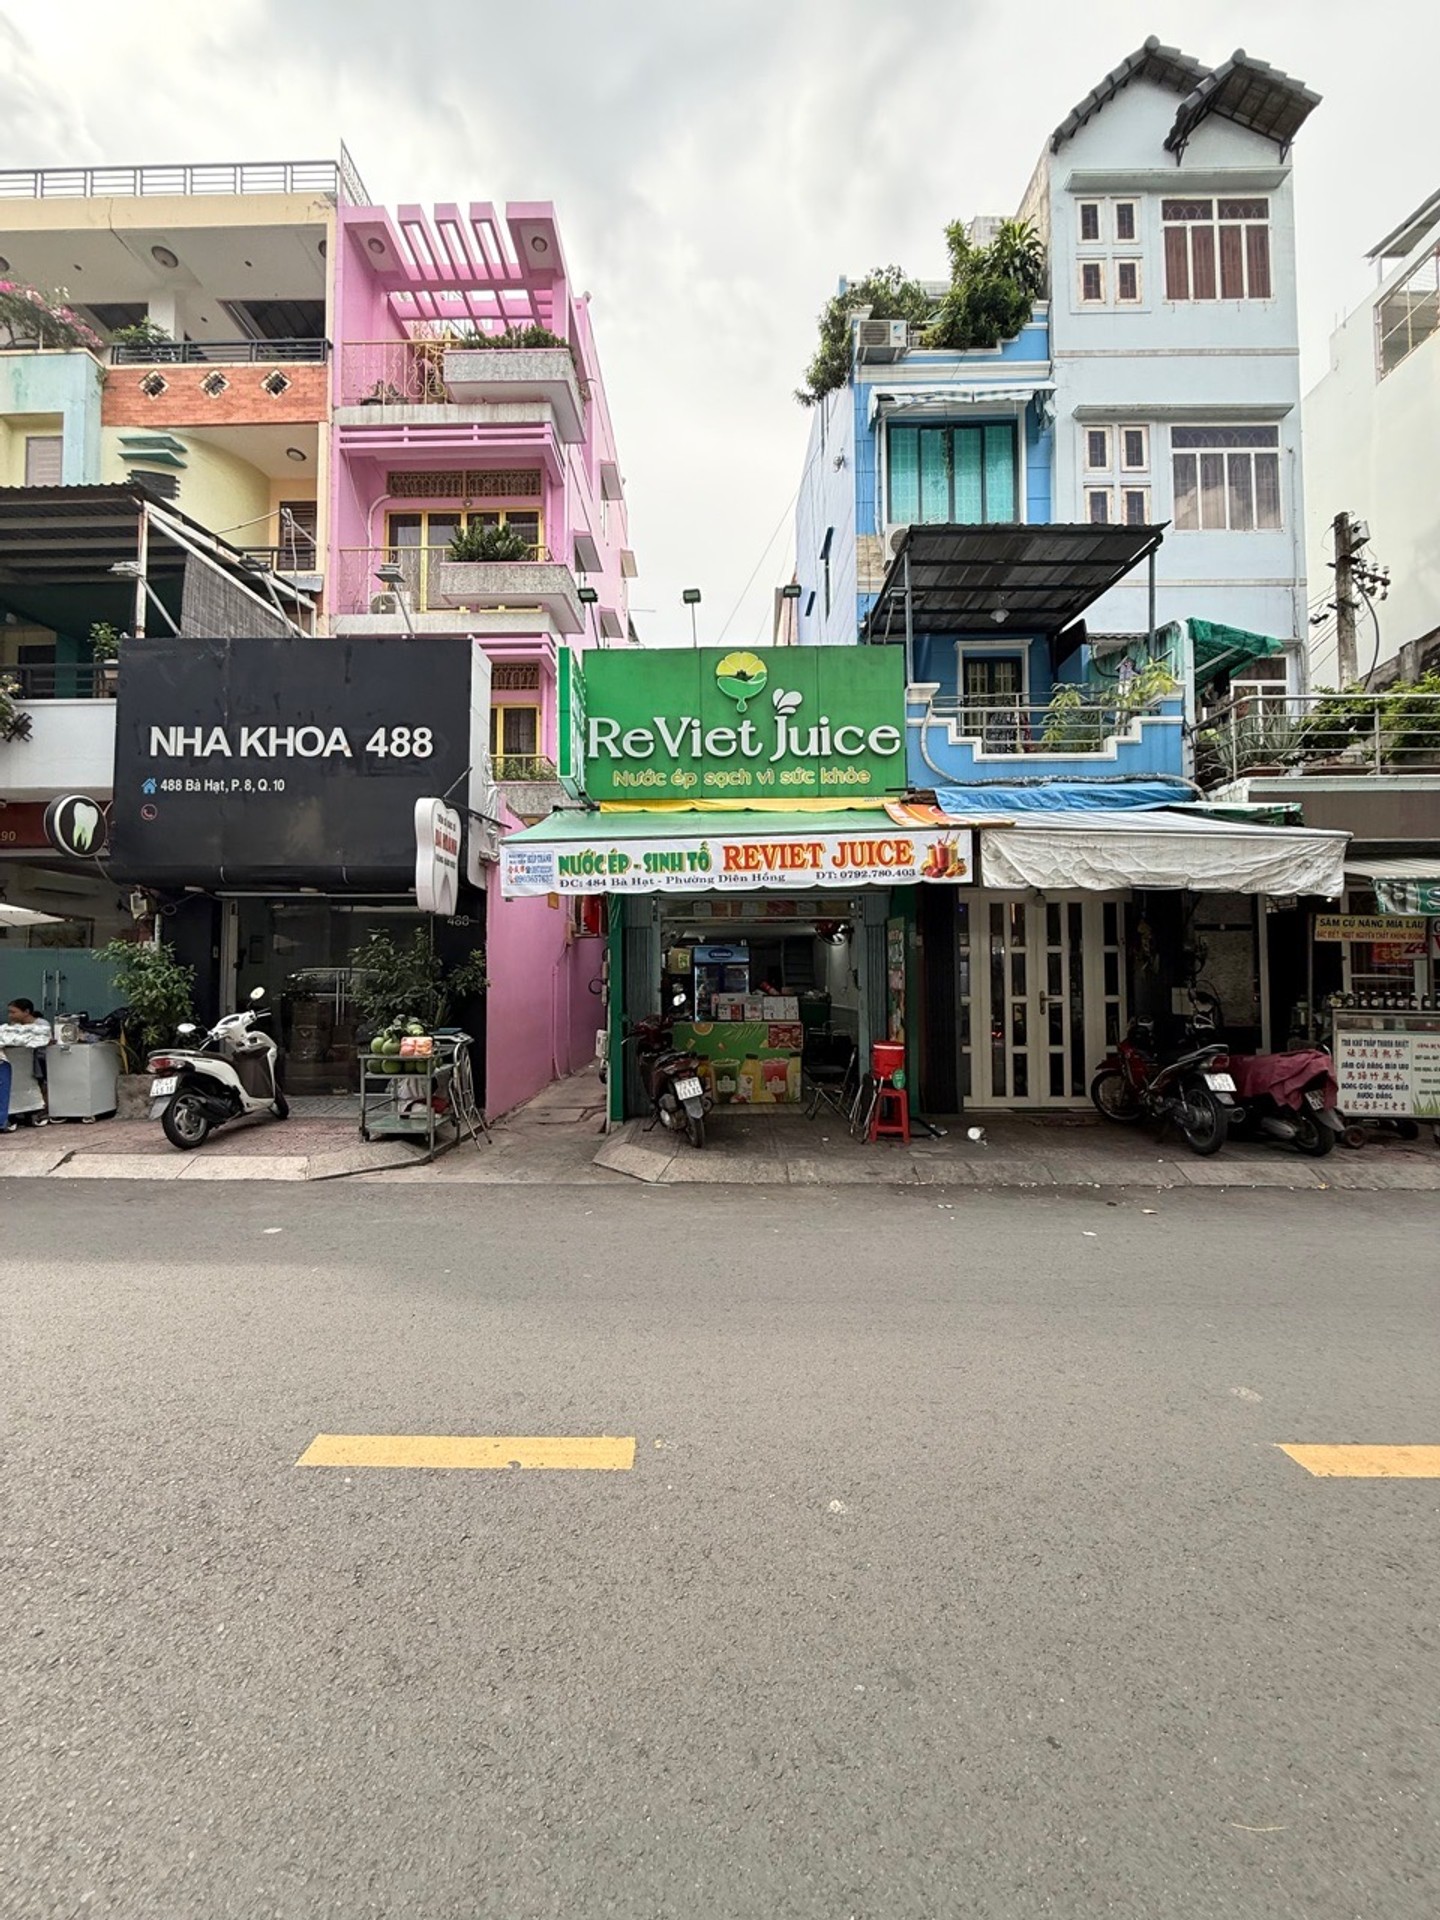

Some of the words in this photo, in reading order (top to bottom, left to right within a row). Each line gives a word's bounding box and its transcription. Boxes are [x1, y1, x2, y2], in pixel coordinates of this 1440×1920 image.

[150, 726, 232, 757] NHA
[240, 726, 352, 757] KHOA
[366, 726, 434, 758] 488
[588, 716, 763, 760] ReViet
[769, 715, 901, 762] Juice
[160, 778, 183, 792] 488
[185, 778, 201, 792] Bà
[204, 778, 229, 795] Hạt,
[613, 768, 667, 787] Nước
[671, 768, 698, 789] ép
[703, 768, 751, 789] sạch
[756, 768, 775, 785] vì
[780, 767, 815, 785] sức
[558, 848, 607, 877] NƯỚC
[608, 848, 631, 874] ÉP
[643, 851, 686, 874] SINH
[687, 840, 714, 873] TỐ
[723, 843, 826, 872] REVIET
[832, 839, 915, 869] JUICE
[585, 877, 607, 887] 484
[611, 876, 628, 887] Bà
[718, 872, 748, 883] Diên
